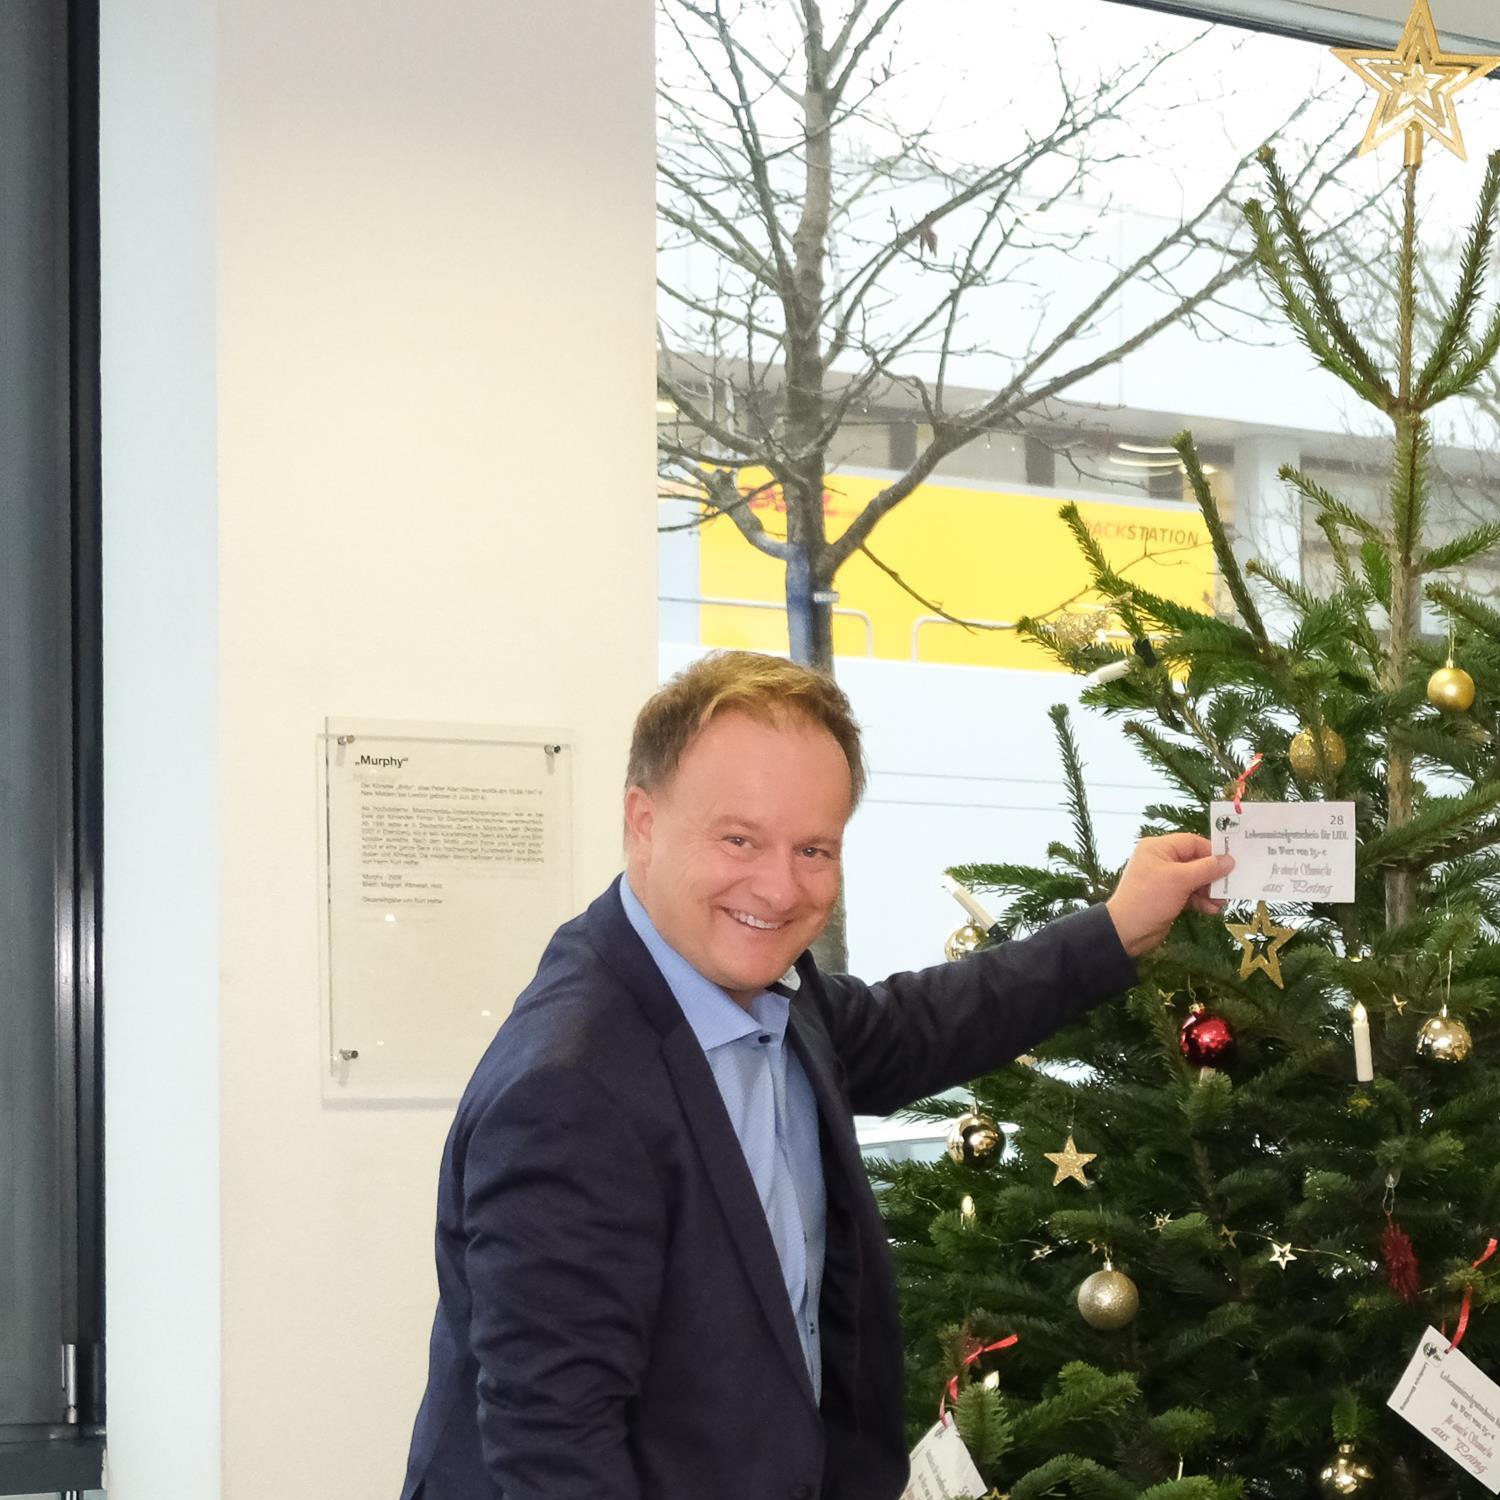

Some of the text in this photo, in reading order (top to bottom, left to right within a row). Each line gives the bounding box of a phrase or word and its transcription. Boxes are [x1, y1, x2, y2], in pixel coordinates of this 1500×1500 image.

[1330, 815, 1344, 825] 28
[1268, 846, 1277, 855] Im
[1278, 846, 1294, 855] Wert
[1262, 879, 1333, 898] aus Poing
[1431, 1427, 1450, 1441] aus
[1454, 1438, 1488, 1474] Poing
